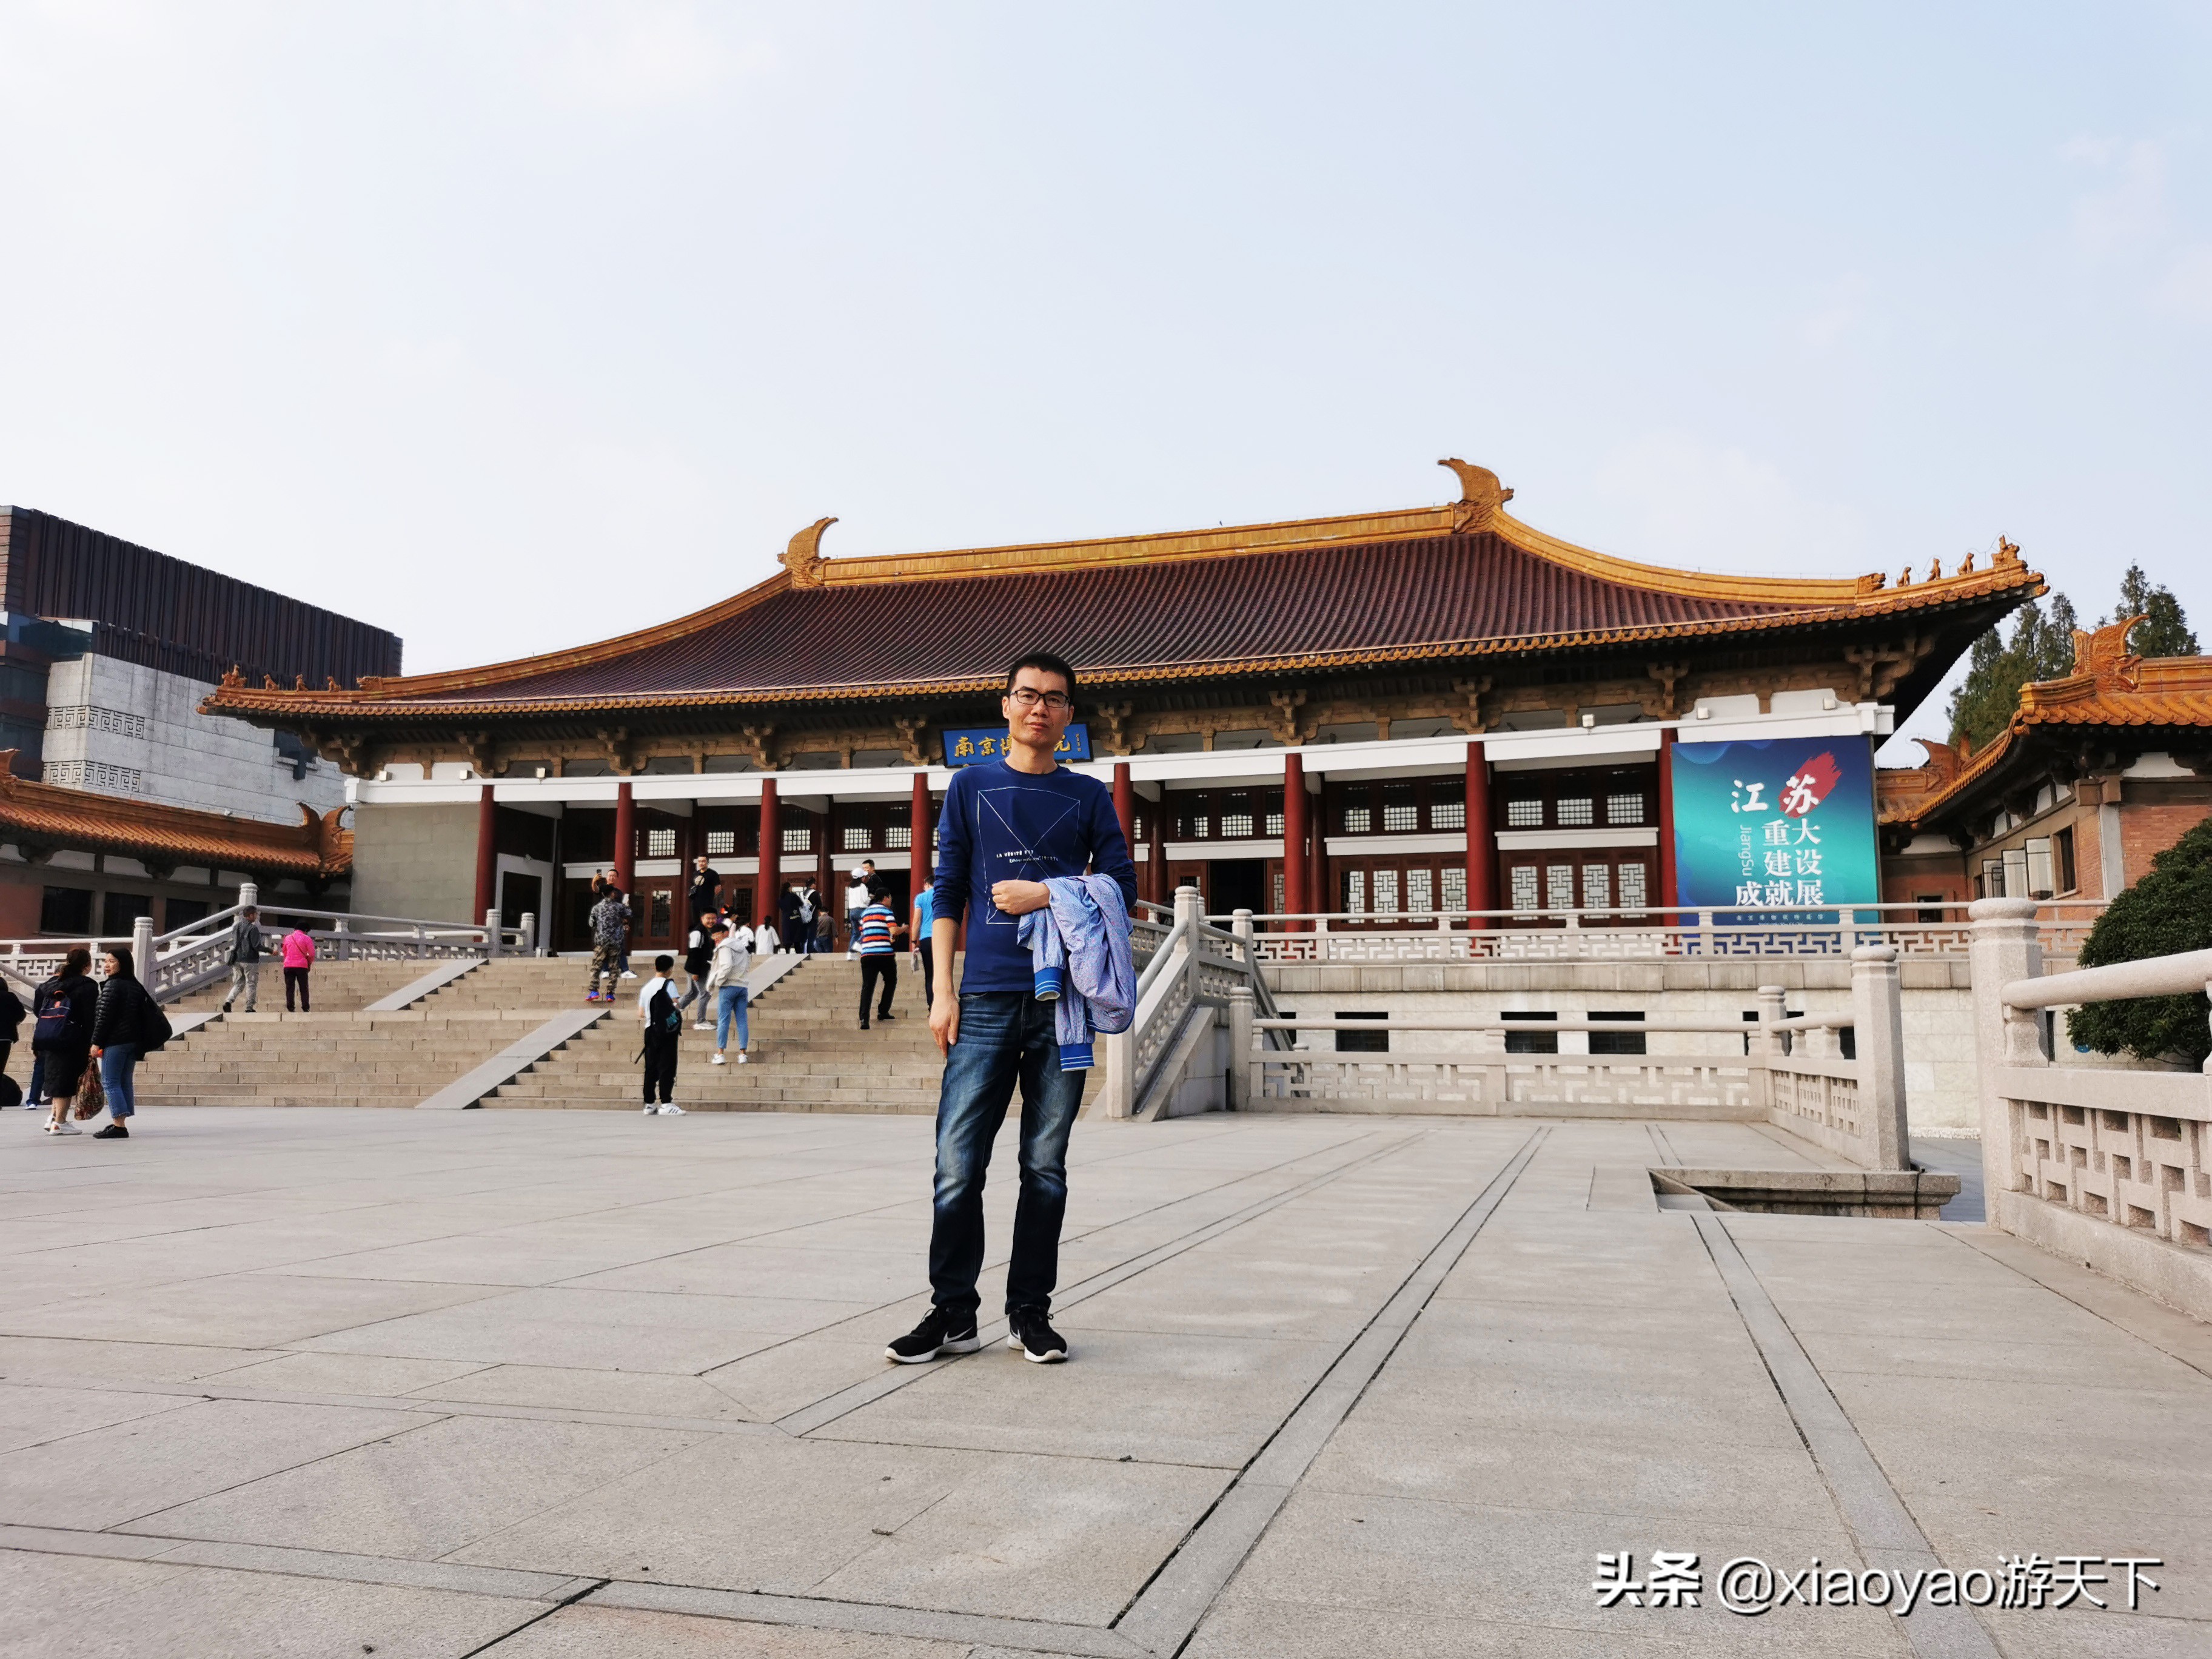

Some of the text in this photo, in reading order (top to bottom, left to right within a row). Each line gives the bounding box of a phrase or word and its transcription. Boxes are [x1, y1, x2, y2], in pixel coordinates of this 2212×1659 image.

[1731, 774, 1819, 814] 江苏
[1762, 818, 1821, 846] 重大
[1738, 825, 1754, 876] JiangSu
[1764, 849, 1822, 877] 建设
[1735, 879, 1825, 906] 成就展
